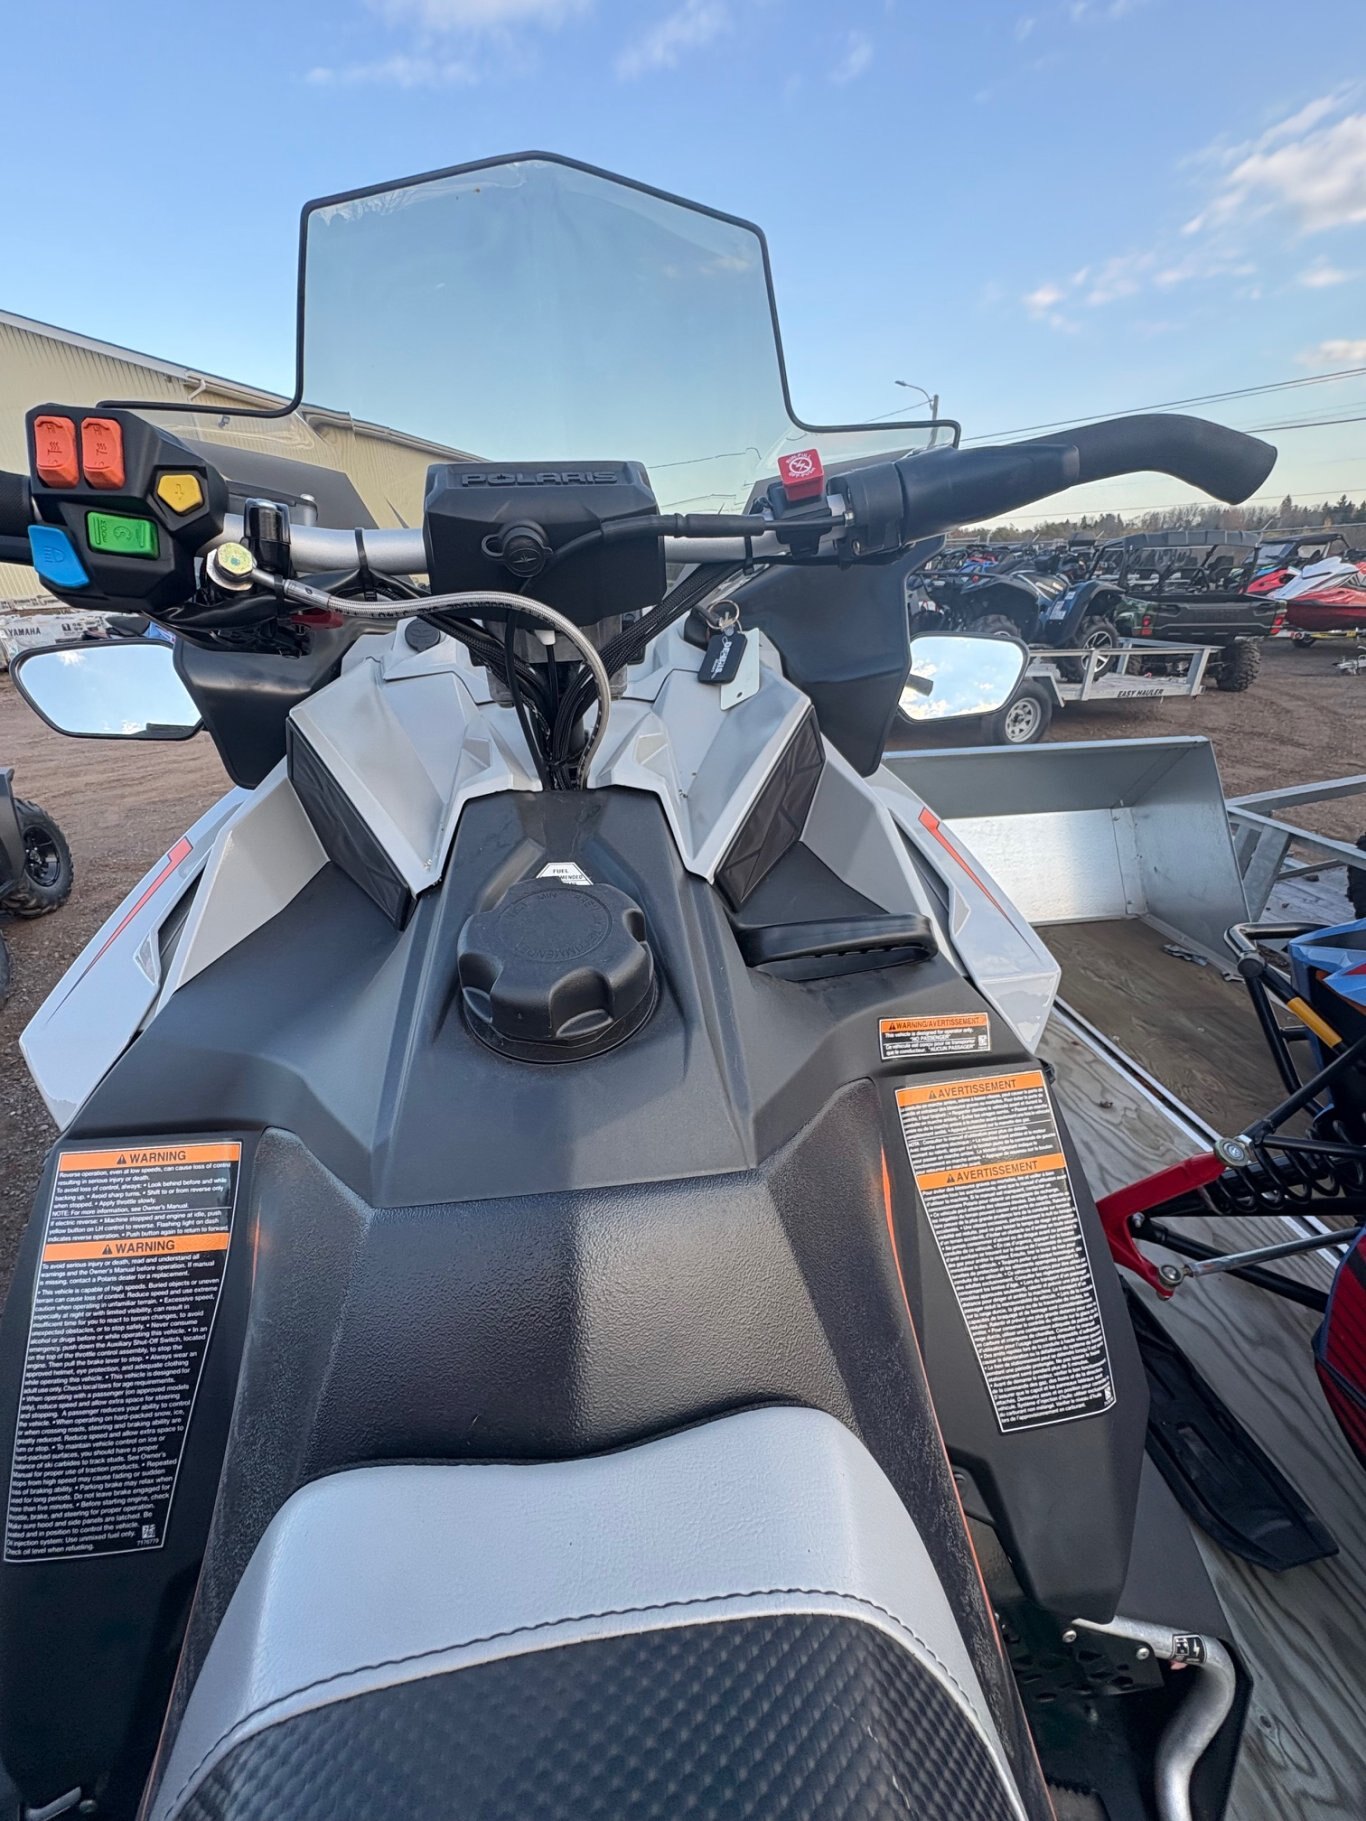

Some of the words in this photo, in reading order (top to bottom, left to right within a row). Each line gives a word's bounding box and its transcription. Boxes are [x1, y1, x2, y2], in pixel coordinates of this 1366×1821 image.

[462, 472, 617, 487] POLARIS
[8, 627, 41, 637] YAMAHA
[1117, 690, 1136, 698] EASY
[1136, 688, 1164, 697] HAULER
[896, 1017, 980, 1030] WARNING/AVERTISSEMENT
[938, 1079, 1017, 1099] AVERTISSEMENT
[130, 1150, 186, 1164] WARNING
[957, 1160, 1038, 1182] AVERTISSEMENT
[115, 1240, 175, 1254] WARNING
[106, 1340, 131, 1348] Auxiliary
[149, 1353, 172, 1361] Always
[25, 1370, 52, 1378] approved
[134, 1362, 163, 1370] adequate
[163, 1360, 188, 1368] clothing
[43, 1393, 72, 1401] operating
[92, 1390, 123, 1398] passenger
[136, 1386, 165, 1394] approved
[13, 1539, 39, 1547] injection
[39, 1536, 63, 1545] system:
